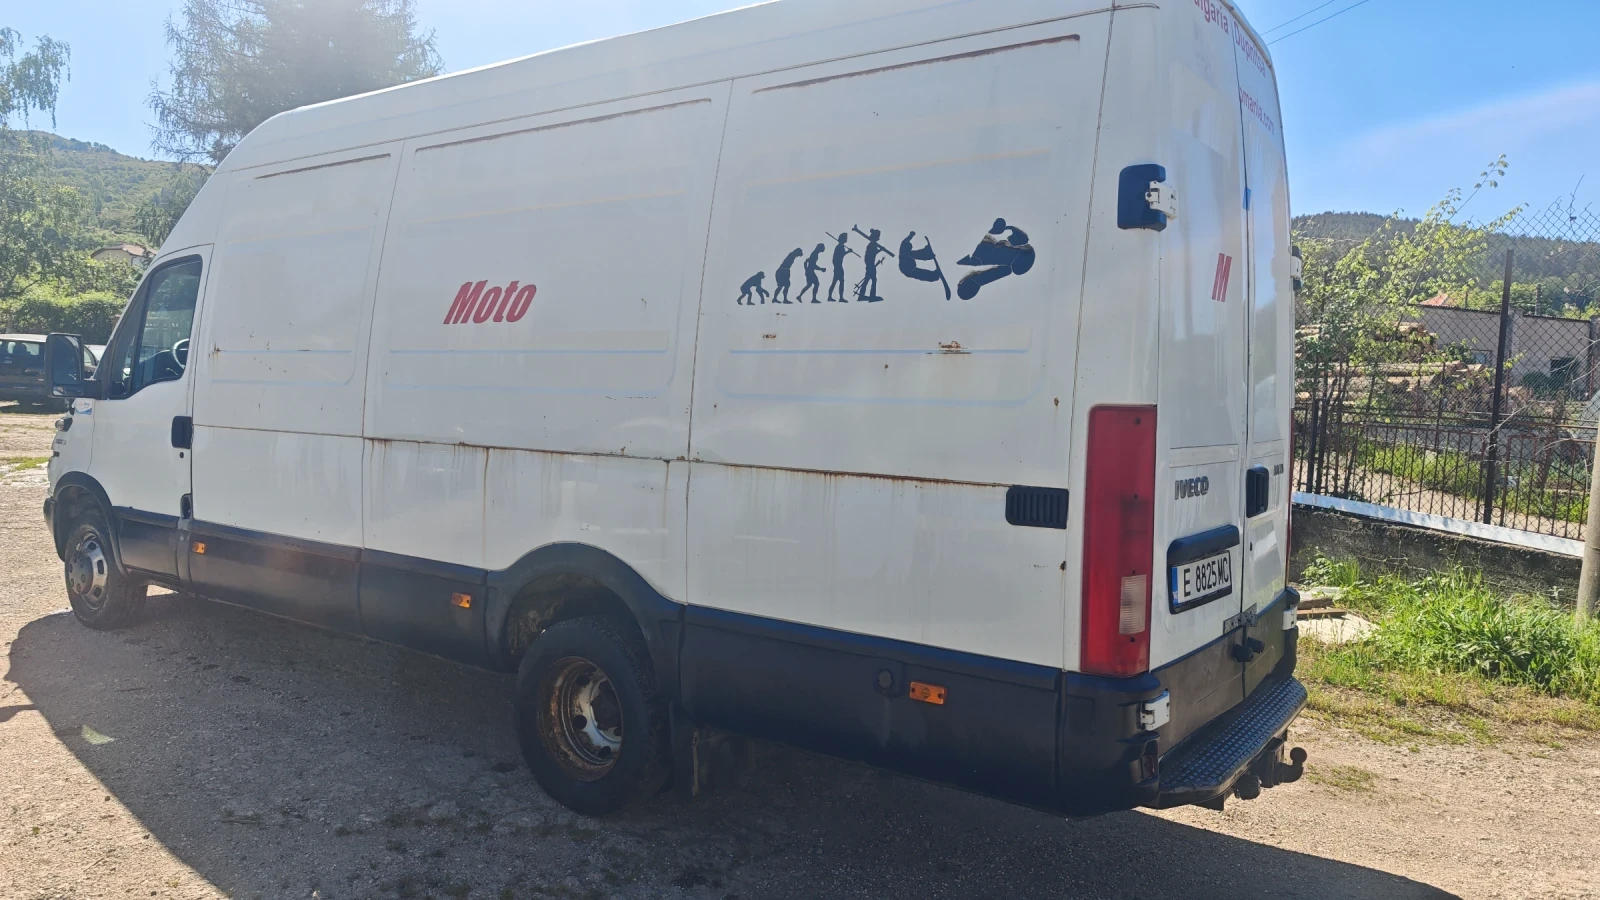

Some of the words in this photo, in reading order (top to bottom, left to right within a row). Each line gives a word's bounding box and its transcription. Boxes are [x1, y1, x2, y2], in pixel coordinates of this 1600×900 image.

[1194, 0, 1229, 34] garia
[1211, 252, 1232, 303] M
[443, 279, 537, 325] Moto
[1174, 475, 1209, 501] IVECO
[1183, 568, 1191, 598] E
